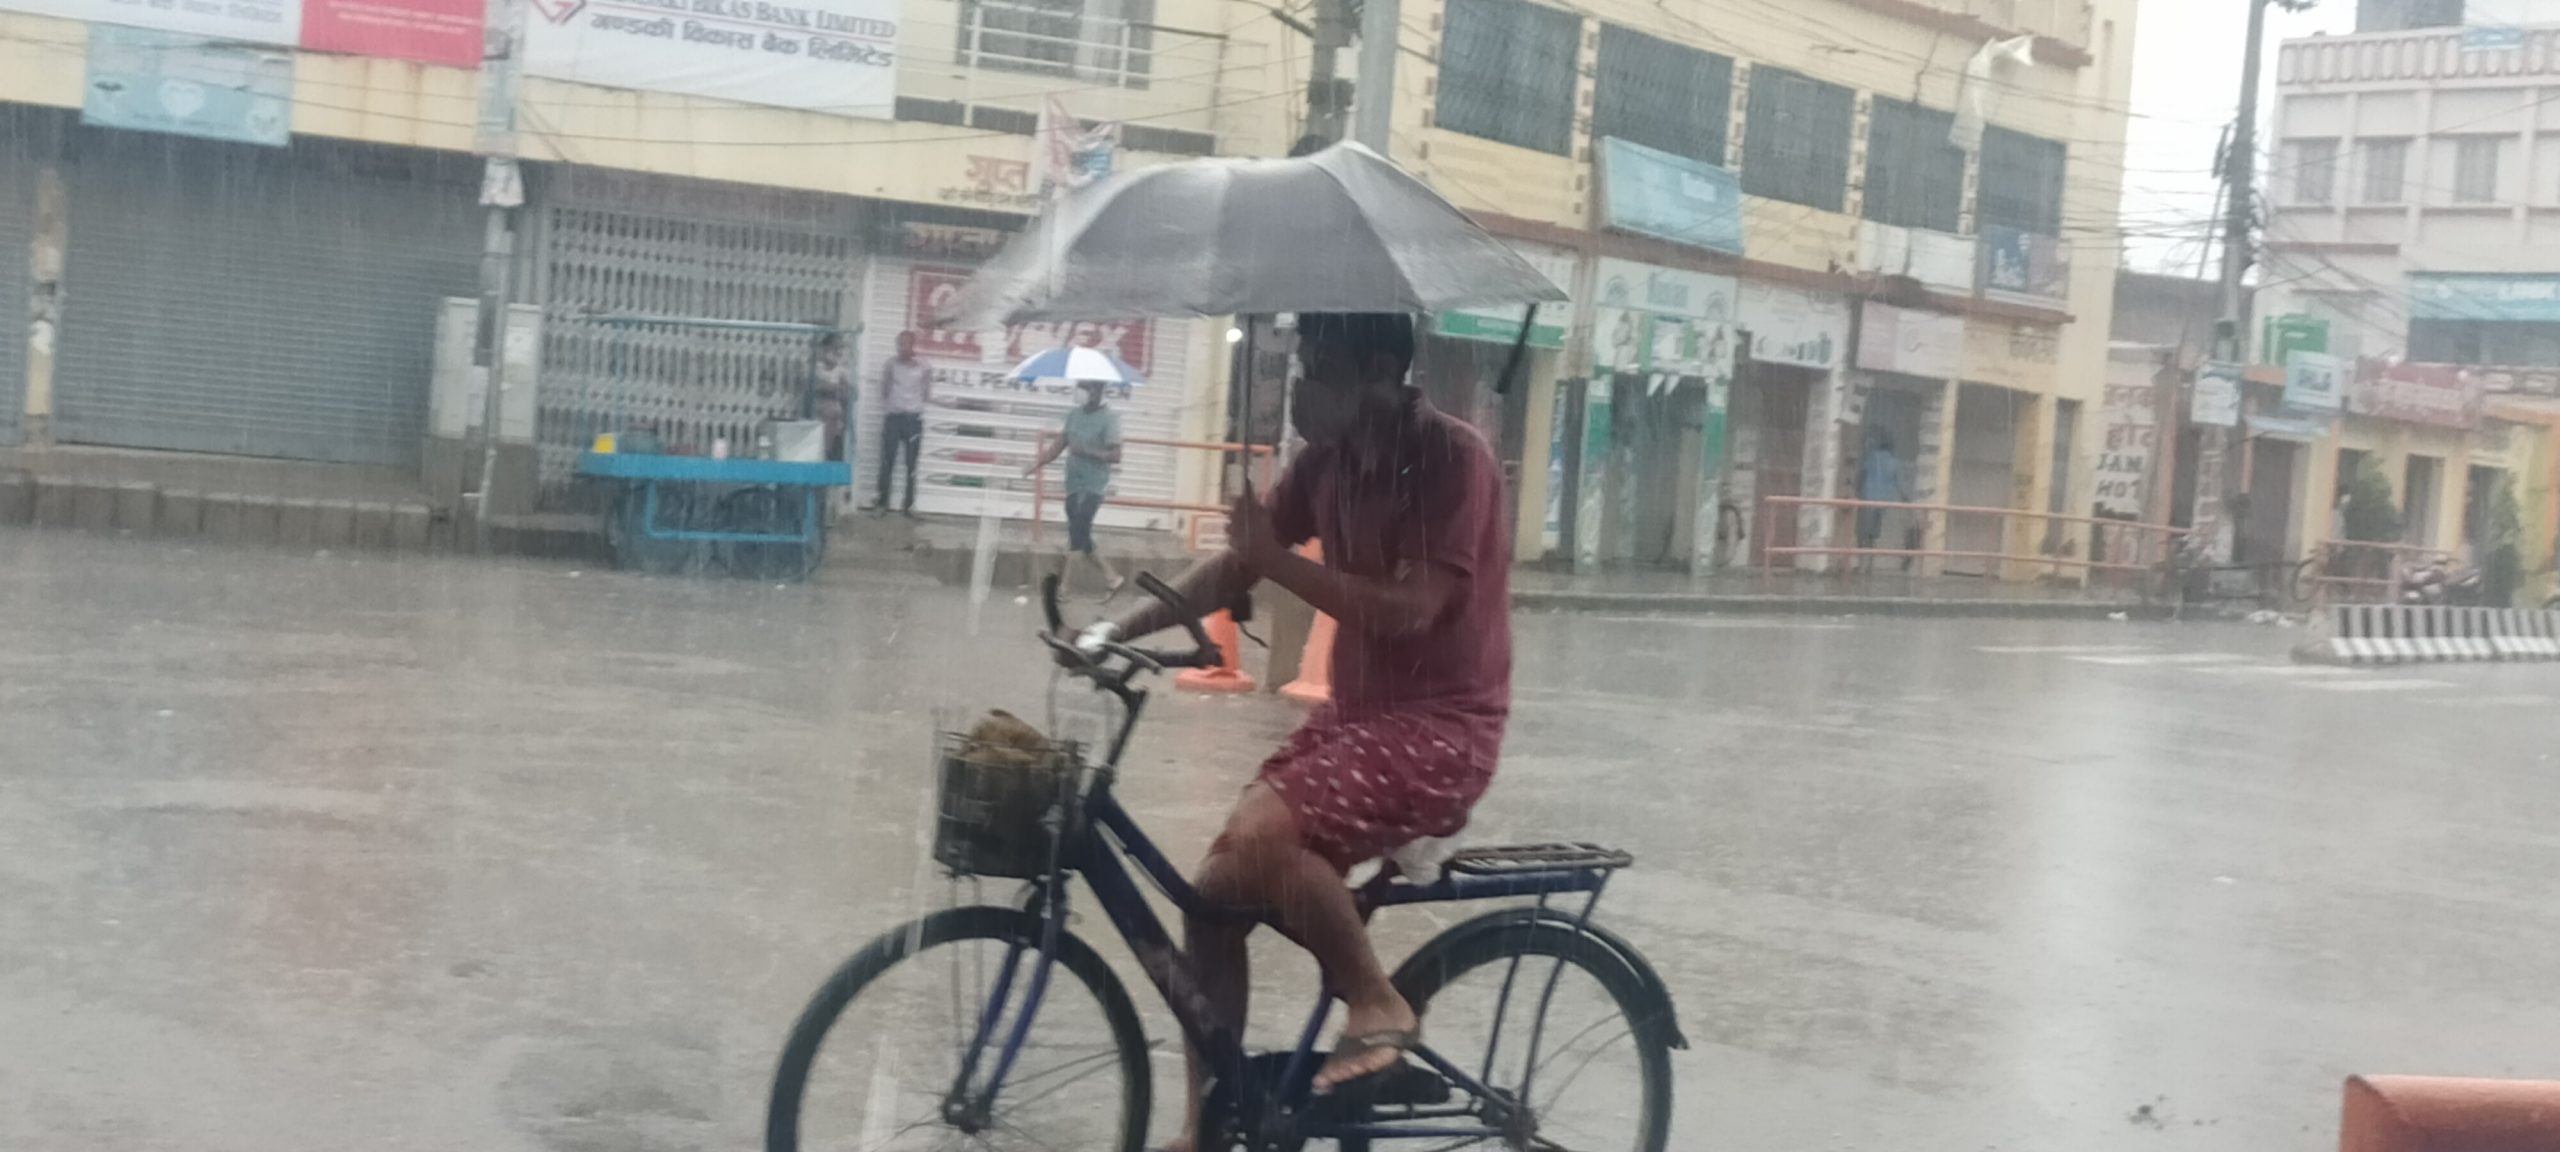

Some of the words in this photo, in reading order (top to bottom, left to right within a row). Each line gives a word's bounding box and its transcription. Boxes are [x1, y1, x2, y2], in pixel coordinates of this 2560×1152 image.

[682, 19, 754, 50] विकास
[756, 2, 810, 27] BANK
[816, 10, 896, 38] LIMITED
